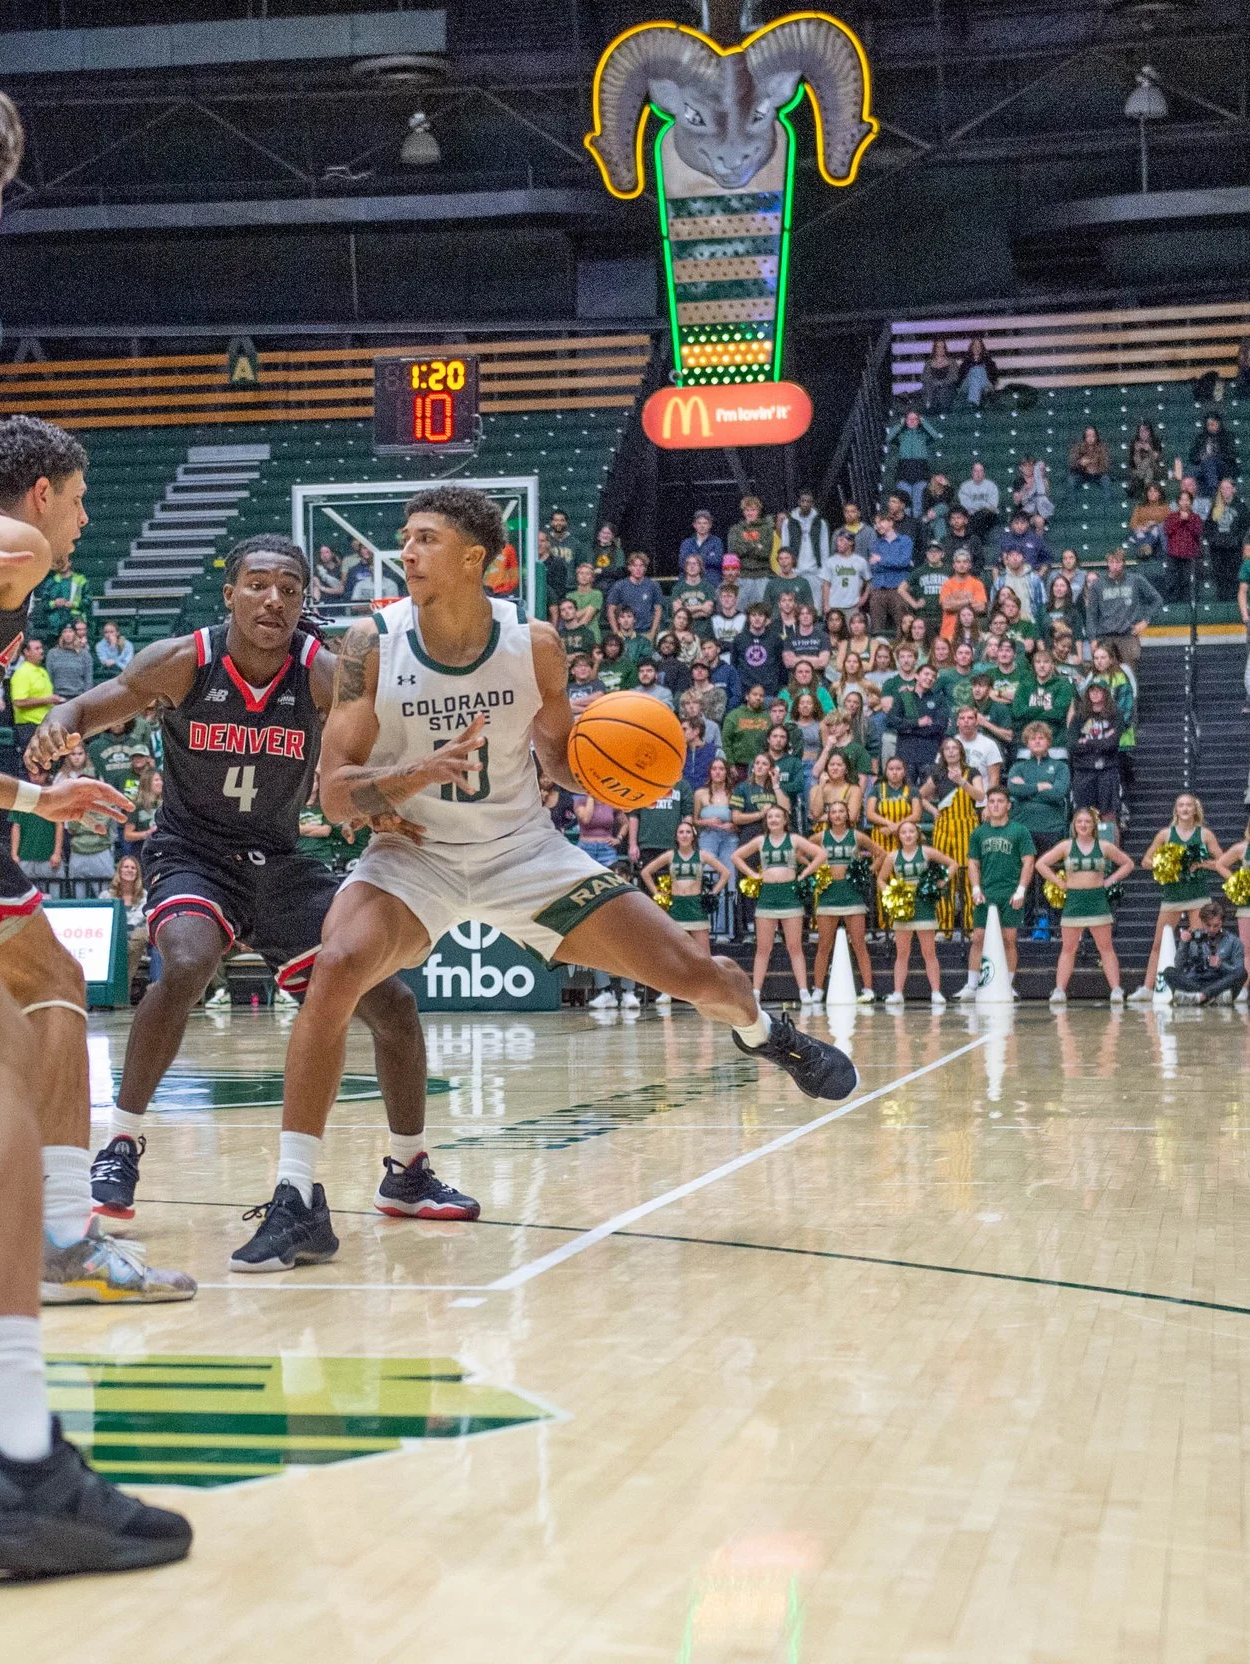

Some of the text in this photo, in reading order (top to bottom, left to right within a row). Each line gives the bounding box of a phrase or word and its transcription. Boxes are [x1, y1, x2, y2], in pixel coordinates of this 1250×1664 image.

[232, 356, 255, 380] A
[411, 361, 465, 391] 1:20
[414, 393, 453, 442] 10
[402, 690, 515, 717] COLORADO
[189, 721, 305, 760] DENVER
[223, 765, 259, 812] 4
[422, 952, 535, 998] fnbo
